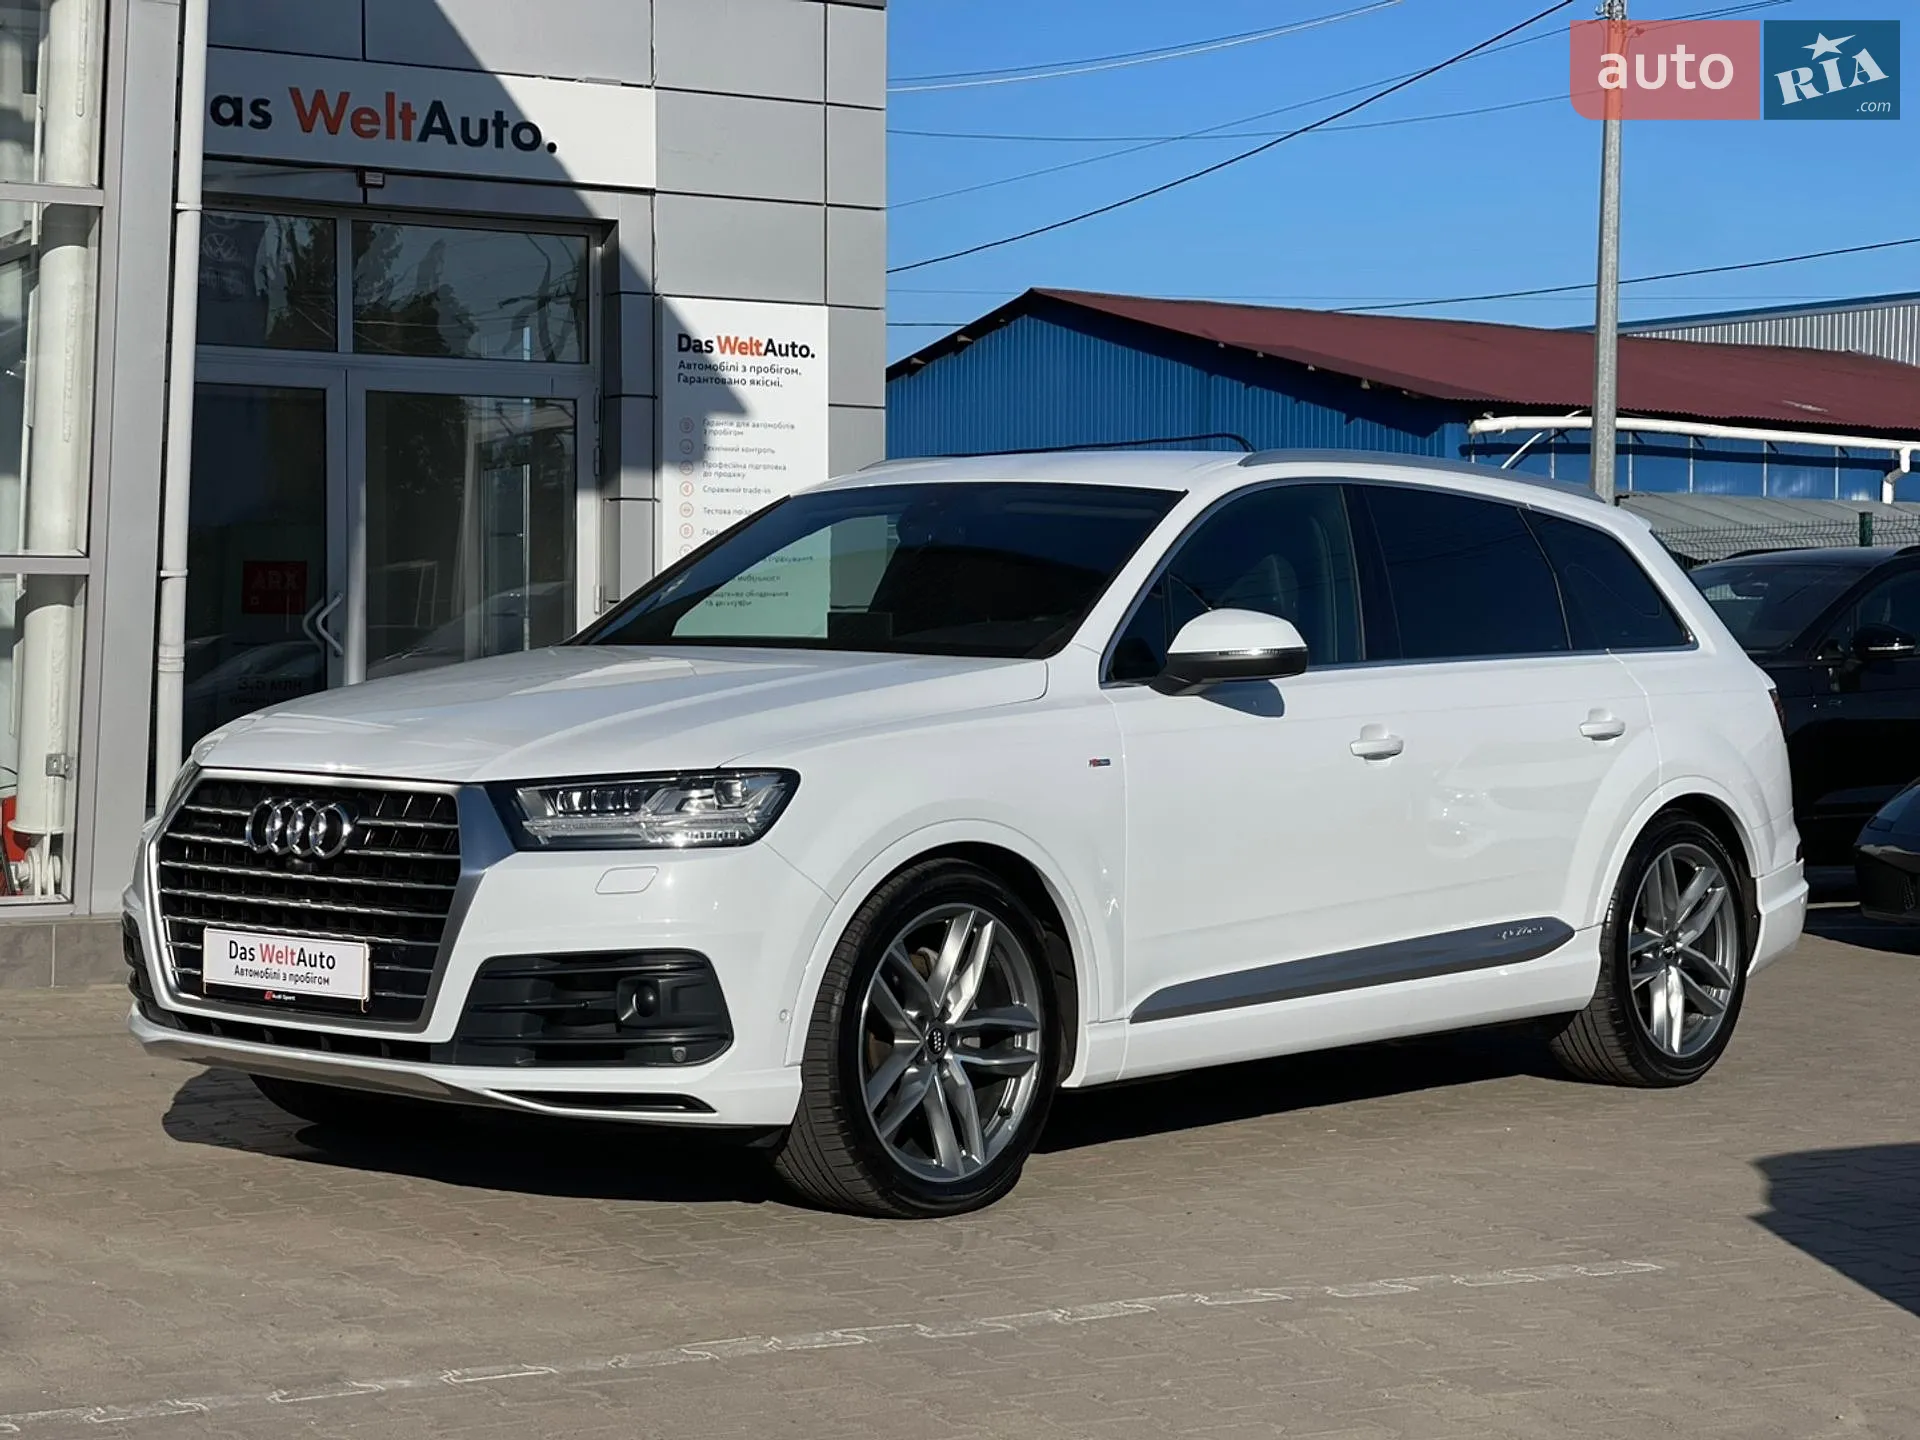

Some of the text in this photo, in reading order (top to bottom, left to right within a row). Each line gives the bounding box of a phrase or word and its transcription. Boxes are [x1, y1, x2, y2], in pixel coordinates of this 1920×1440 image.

[209, 87, 558, 155] as WeltAuto.
[677, 333, 816, 359] Das WeltAuto.
[678, 360, 802, 376] Автомобілі з пробігом.
[678, 373, 783, 388] Гарантовано якісні.
[229, 940, 336, 970] Das WeltAuto
[234, 965, 280, 981] Автомобілі
[289, 972, 330, 986] пробігом
